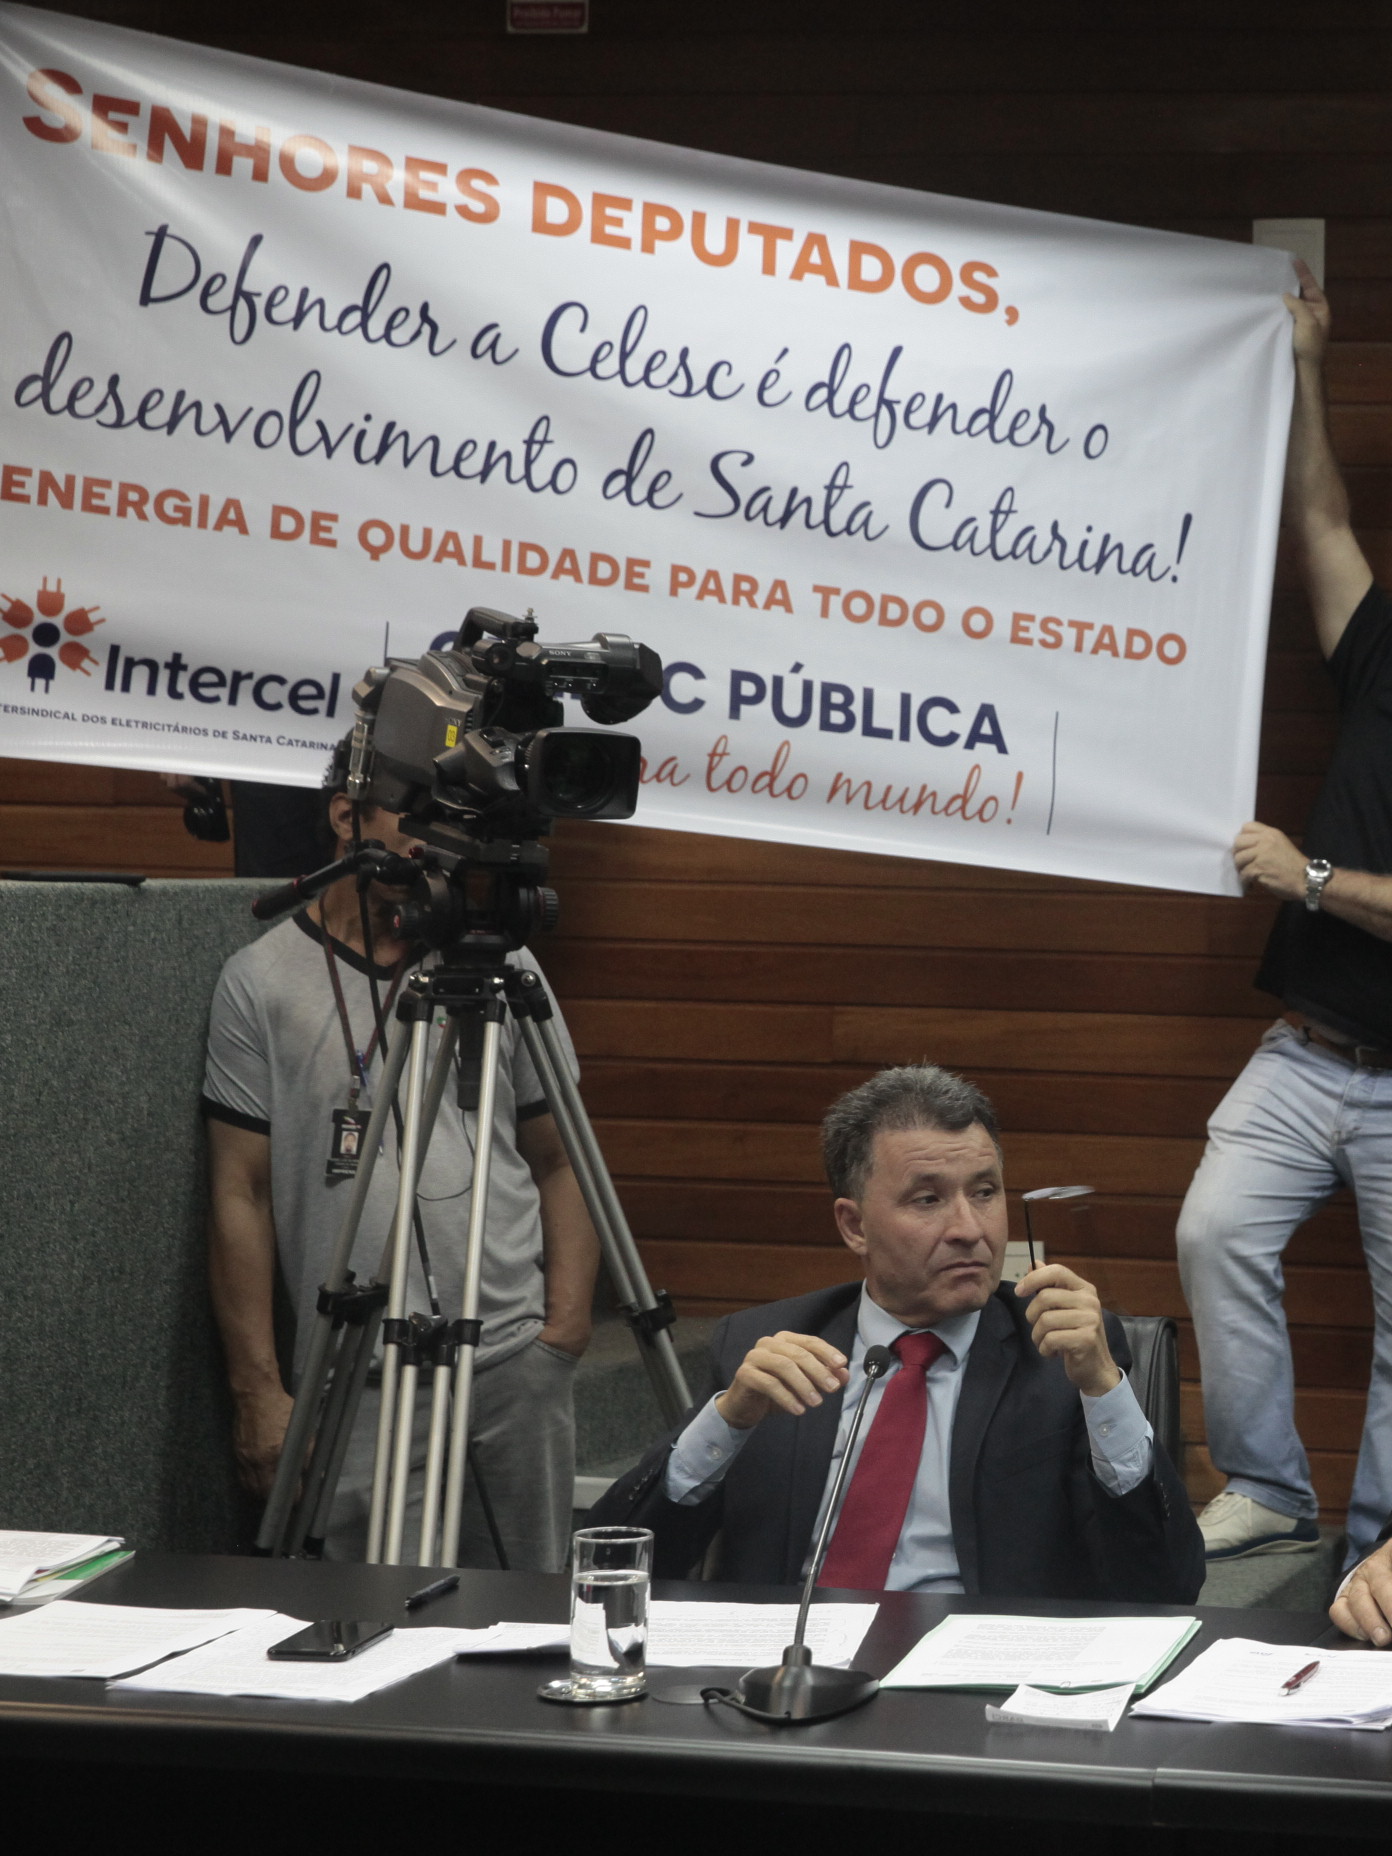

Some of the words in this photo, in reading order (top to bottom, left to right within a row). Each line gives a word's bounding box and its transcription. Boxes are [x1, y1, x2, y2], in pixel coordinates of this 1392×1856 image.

[22, 68, 500, 224] SENHORES
[532, 181, 1019, 326] DEPUTADOS,
[139, 224, 457, 357] Defender
[470, 323, 519, 366] a
[541, 301, 744, 401] Celesc
[757, 347, 790, 408] é
[805, 342, 1069, 459] defender
[1084, 424, 1108, 460] o
[14, 331, 577, 495] desenvolvimento
[602, 428, 683, 510] de
[693, 450, 889, 542] Santa
[909, 478, 1192, 582] Catarina!
[0, 465, 249, 536] ENERGIA
[270, 505, 339, 548] DE
[358, 520, 651, 593] QUALIDADE
[669, 564, 793, 614] PARA
[813, 585, 945, 632] TODO
[962, 606, 994, 640] O
[1010, 613, 1187, 665] ESTADO
[81, 713, 107, 725] DOS
[111, 717, 209, 737] ELETRICITÁRIOS
[213, 729, 228, 739] DE
[105, 643, 341, 718] Intercel
[729, 662, 1008, 755] PÚBLICA
[705, 735, 808, 801] todo
[826, 765, 1024, 824] mundo!
